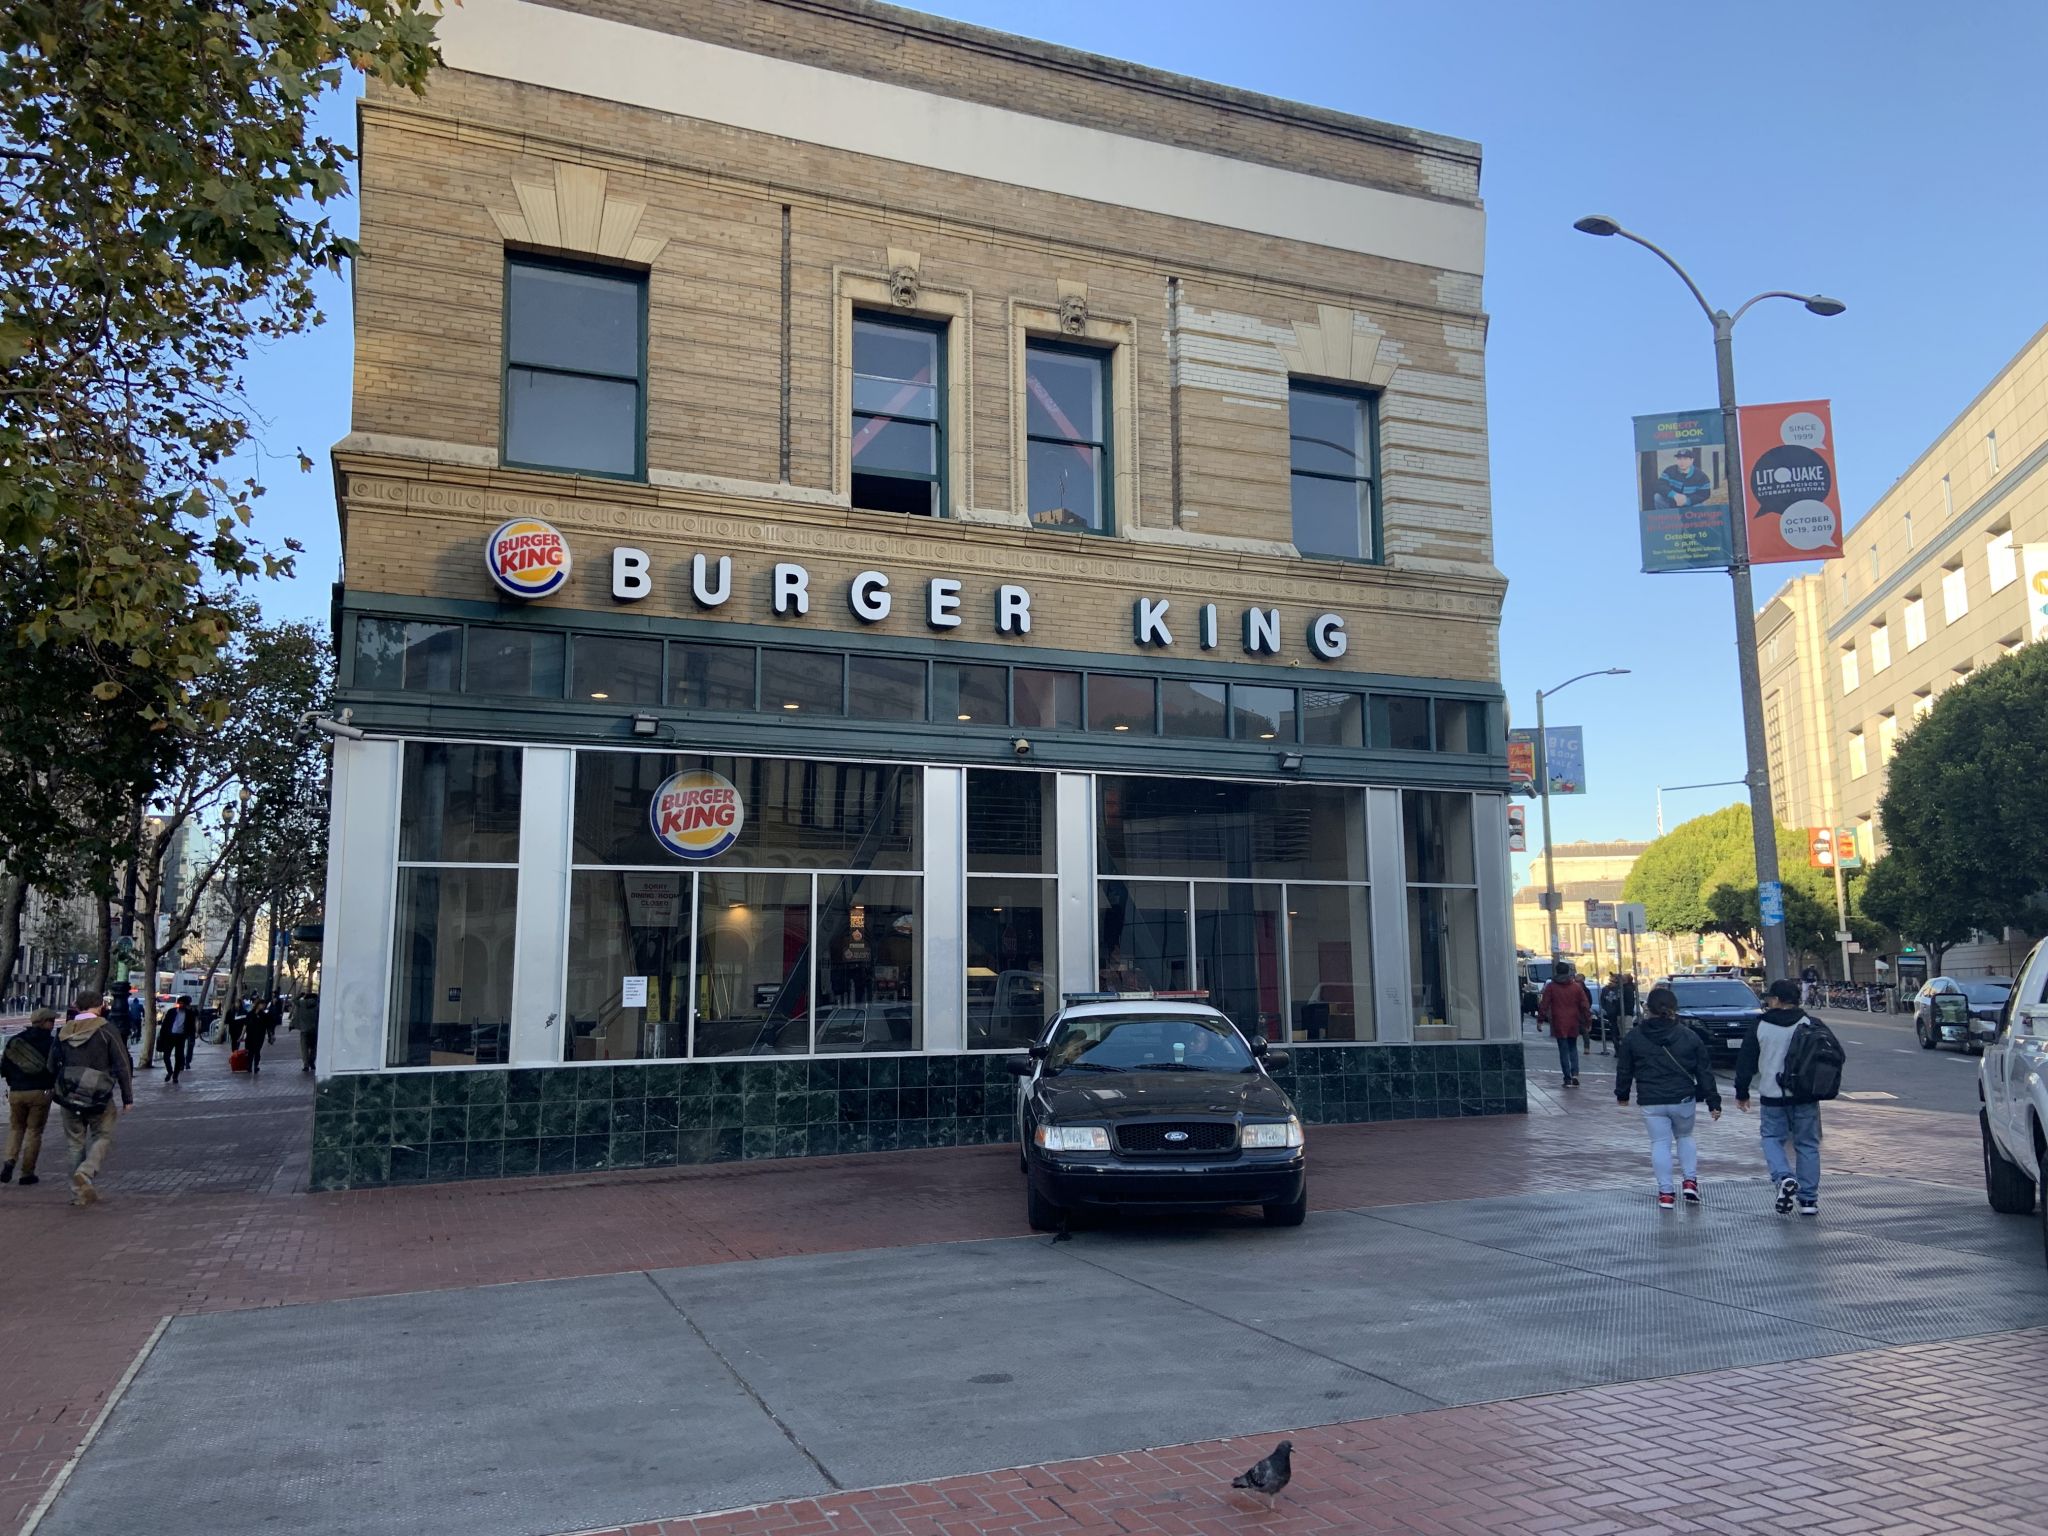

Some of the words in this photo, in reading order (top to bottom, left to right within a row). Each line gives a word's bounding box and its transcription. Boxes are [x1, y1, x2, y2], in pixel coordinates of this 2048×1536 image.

[1788, 424, 1816, 433] SINCE
[1756, 466, 1825, 486] LITQUAKE
[1758, 489, 1791, 497] LITERARY
[1785, 516, 1829, 525] OCTOBER
[1664, 532, 1697, 541] October
[1784, 526, 1810, 535] 10-19,
[1812, 524, 1832, 532] 2019
[498, 533, 560, 556] BURGER
[500, 546, 563, 576] KING
[611, 546, 1031, 634] BURGER
[1135, 597, 1348, 659] KING
[1549, 736, 1578, 751] BIG
[661, 788, 735, 812] BURGER
[661, 803, 736, 835] KING
